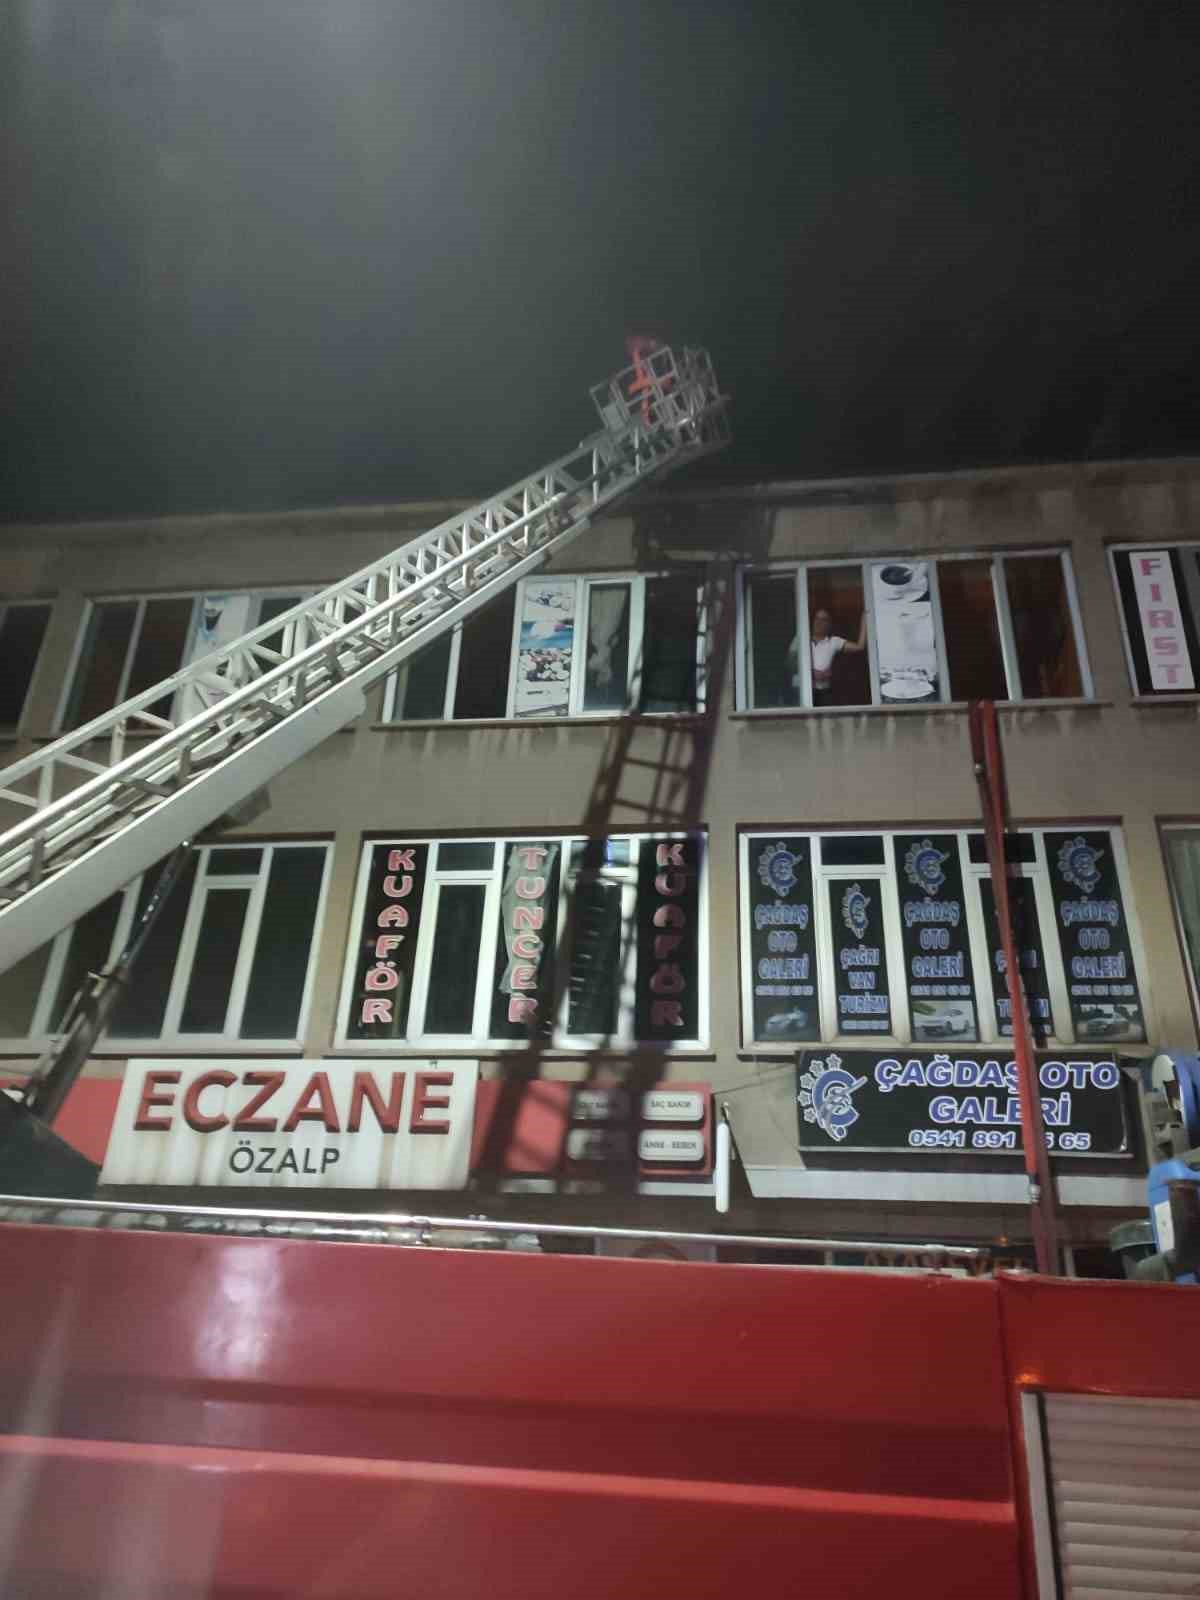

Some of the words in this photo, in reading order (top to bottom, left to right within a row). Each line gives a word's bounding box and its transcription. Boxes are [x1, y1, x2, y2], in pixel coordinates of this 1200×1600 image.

[1140, 557, 1185, 684] FIRST
[362, 848, 417, 1024] KUAFÖR
[650, 843, 687, 1026] KUAFÖR
[920, 928, 949, 950] OTO
[1078, 928, 1110, 950] OTO
[875, 1055, 1020, 1093] ÇAĞDAŞ
[1039, 1061, 1120, 1089] OTO
[133, 1069, 455, 1134] ECZANE
[928, 1092, 1072, 1126] GALERİ
[229, 1140, 341, 1174] ÖZALP
[909, 1130, 966, 1148] 0541
[972, 1130, 1016, 1149] 891
[1058, 1132, 1091, 1150] 65
